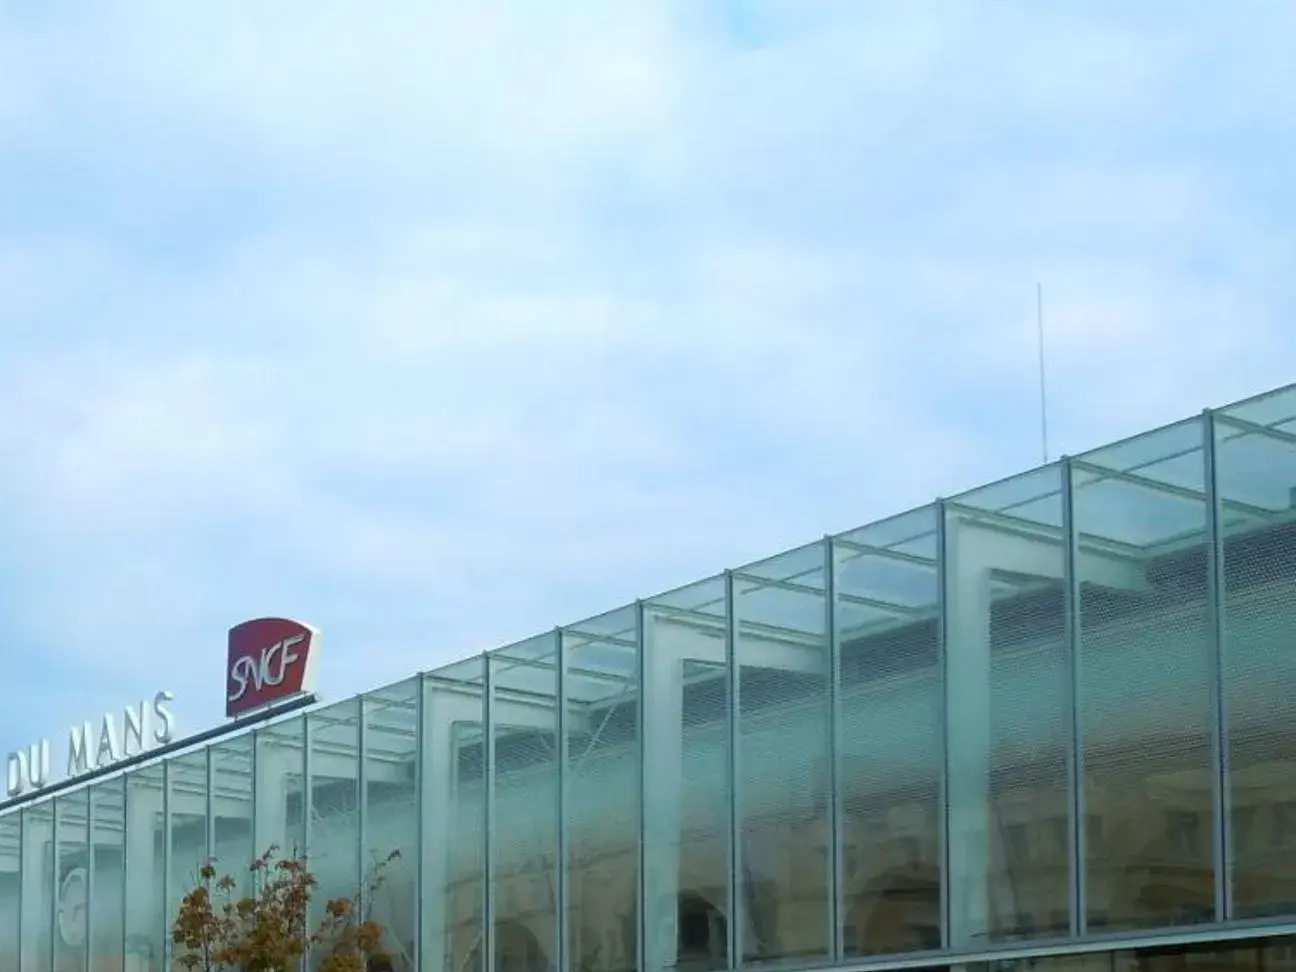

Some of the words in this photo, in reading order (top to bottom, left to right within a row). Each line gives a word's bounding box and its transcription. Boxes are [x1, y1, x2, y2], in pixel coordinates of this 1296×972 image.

[228, 633, 306, 701] SNCF
[7, 738, 50, 797] DU
[67, 691, 174, 777] MANS
